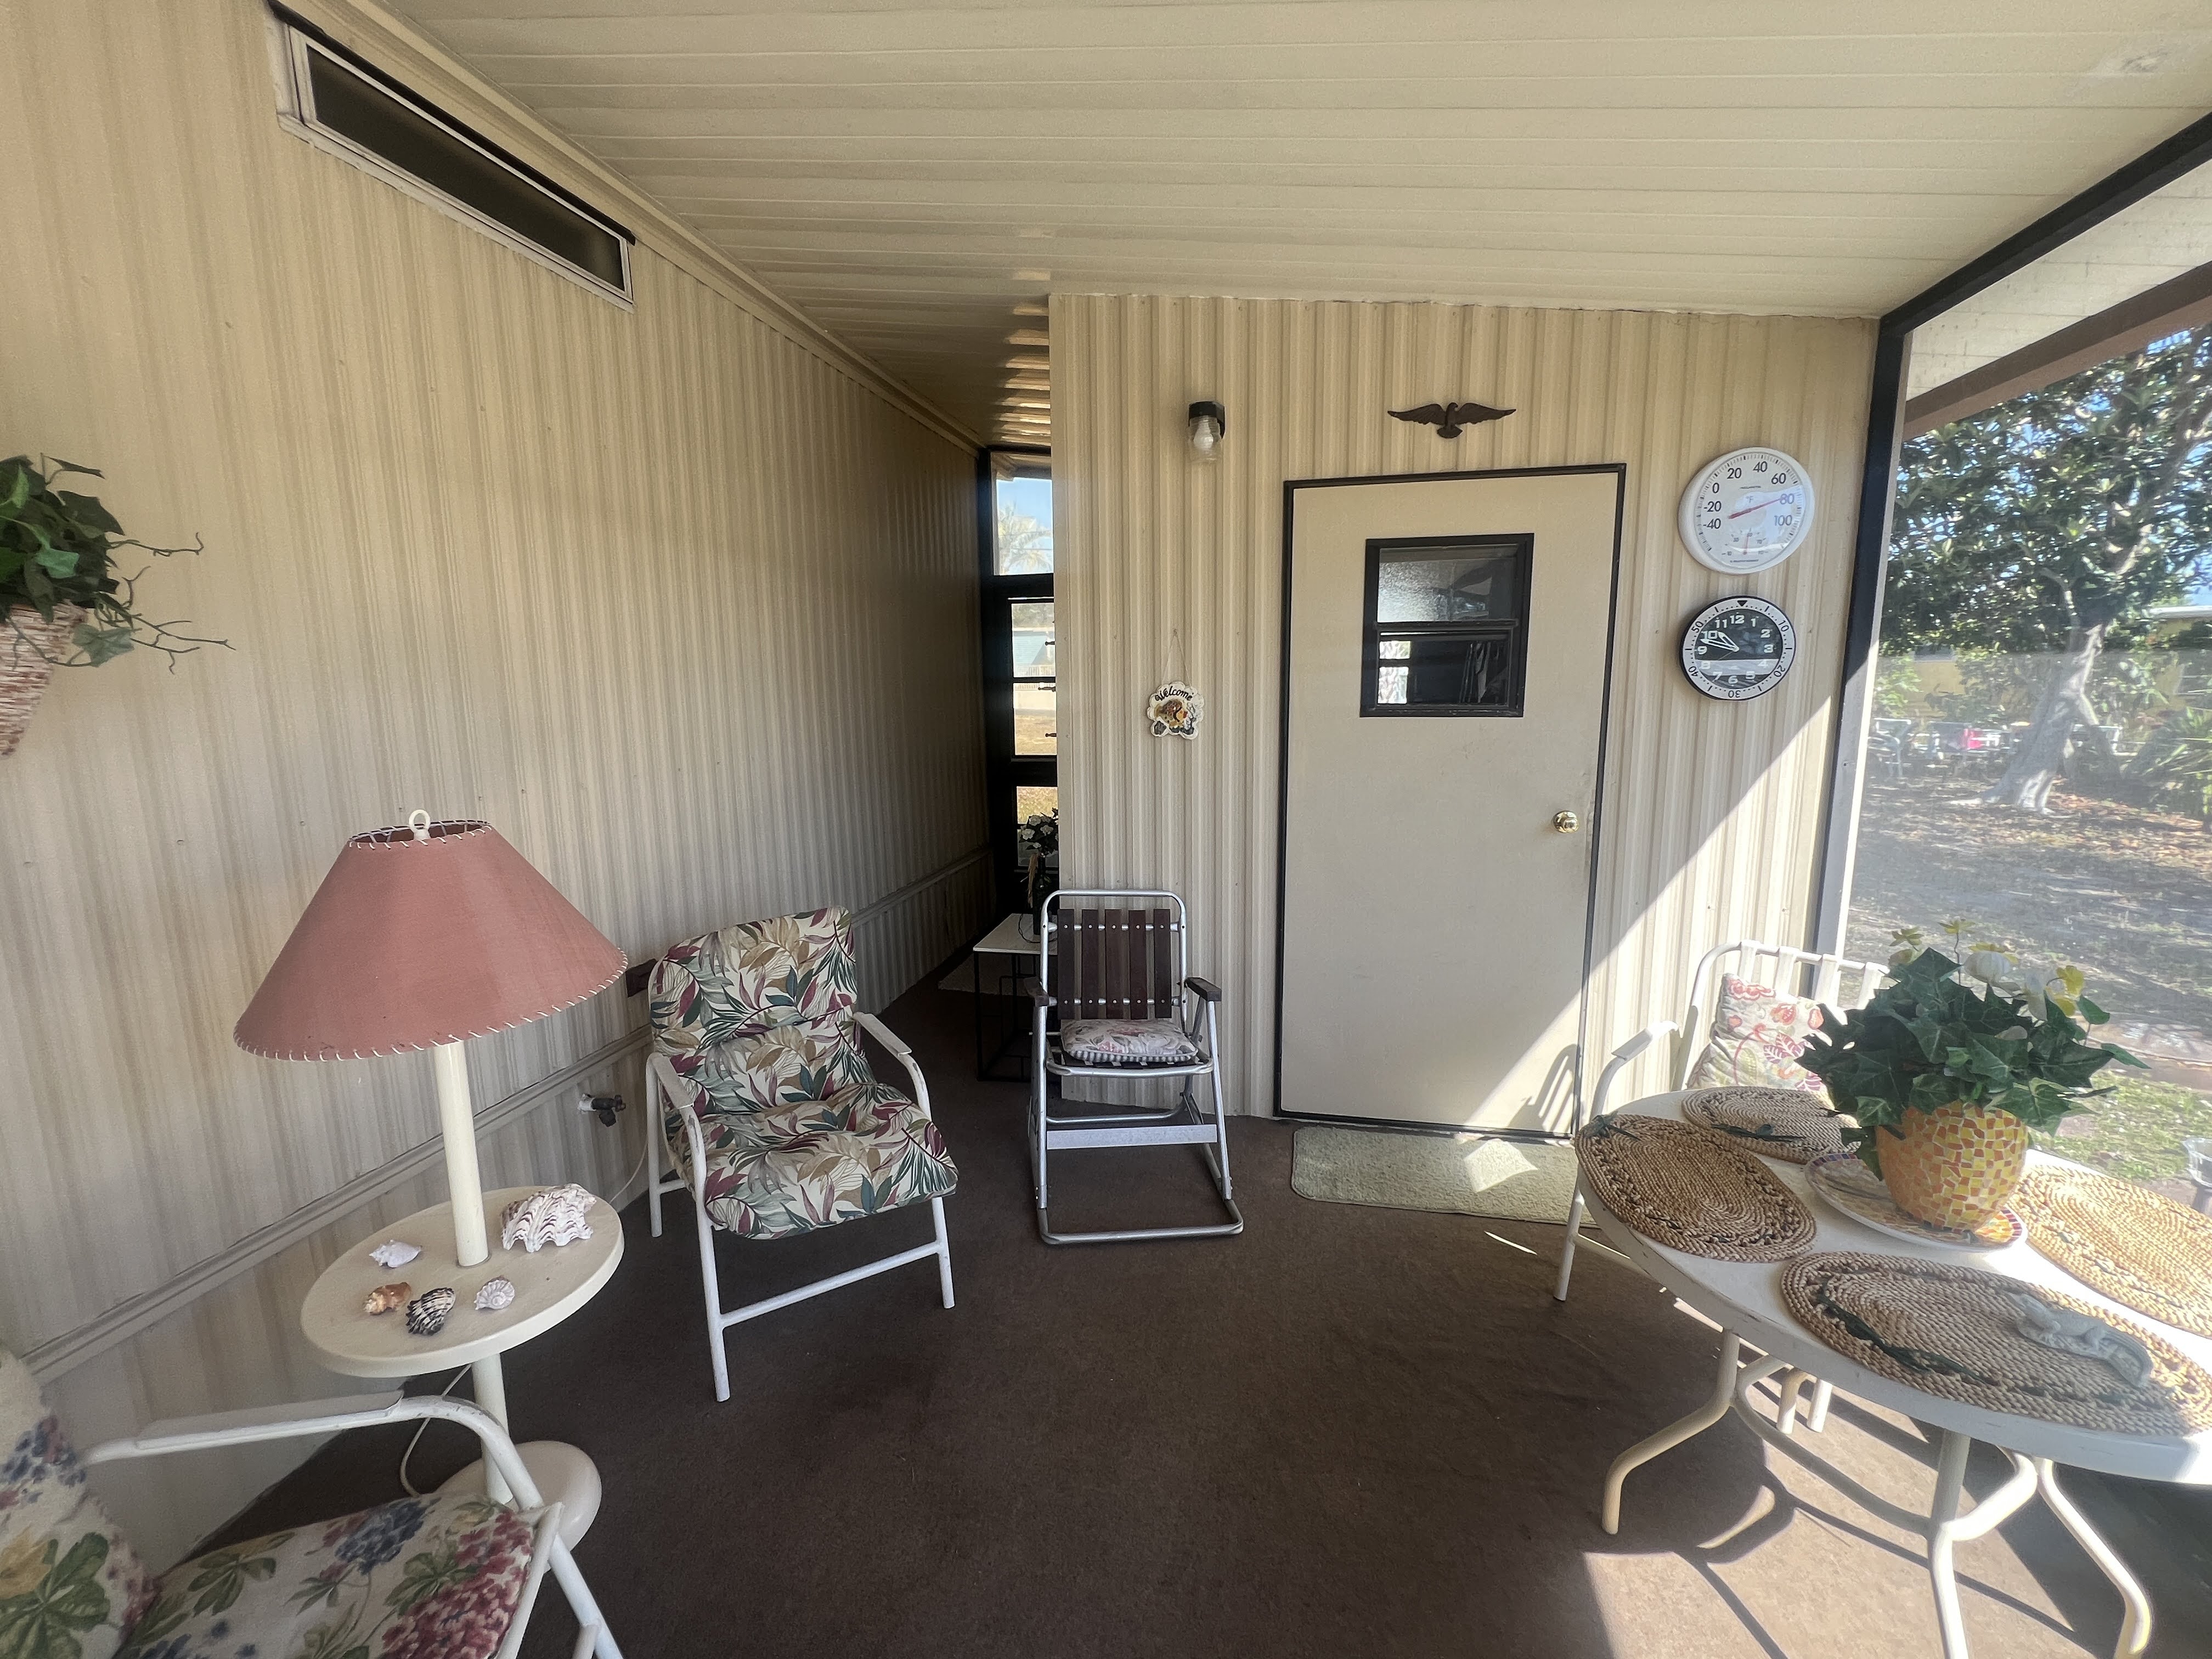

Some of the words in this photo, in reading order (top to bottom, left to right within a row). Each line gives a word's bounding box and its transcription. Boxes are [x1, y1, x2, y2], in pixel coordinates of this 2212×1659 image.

[1753, 461, 1768, 472] 40
[1727, 468, 1742, 479] 20
[1771, 473, 1786, 484] 60
[1712, 483, 1719, 493] 0
[1780, 494, 1795, 504] 80
[1704, 501, 1722, 512] -20
[1703, 518, 1721, 529] -40
[1774, 515, 1792, 526] 100
[1715, 619, 1728, 629] 11
[1730, 615, 1745, 624] 12
[1751, 618, 1756, 627] 1
[1691, 621, 1703, 633] 50
[1778, 620, 1789, 632] 10
[1702, 630, 1718, 639] 10
[1760, 629, 1770, 638] 2
[1697, 646, 1707, 654] 9
[1764, 644, 1773, 653] 3
[1701, 661, 1711, 669] 8
[1758, 659, 1768, 668] 4
[1688, 665, 1699, 677] 40
[1713, 672, 1723, 680] 7
[1746, 671, 1755, 679] 5
[1774, 665, 1785, 677] 20
[1728, 675, 1738, 684] 6
[1155, 686, 1193, 701] Welcome
